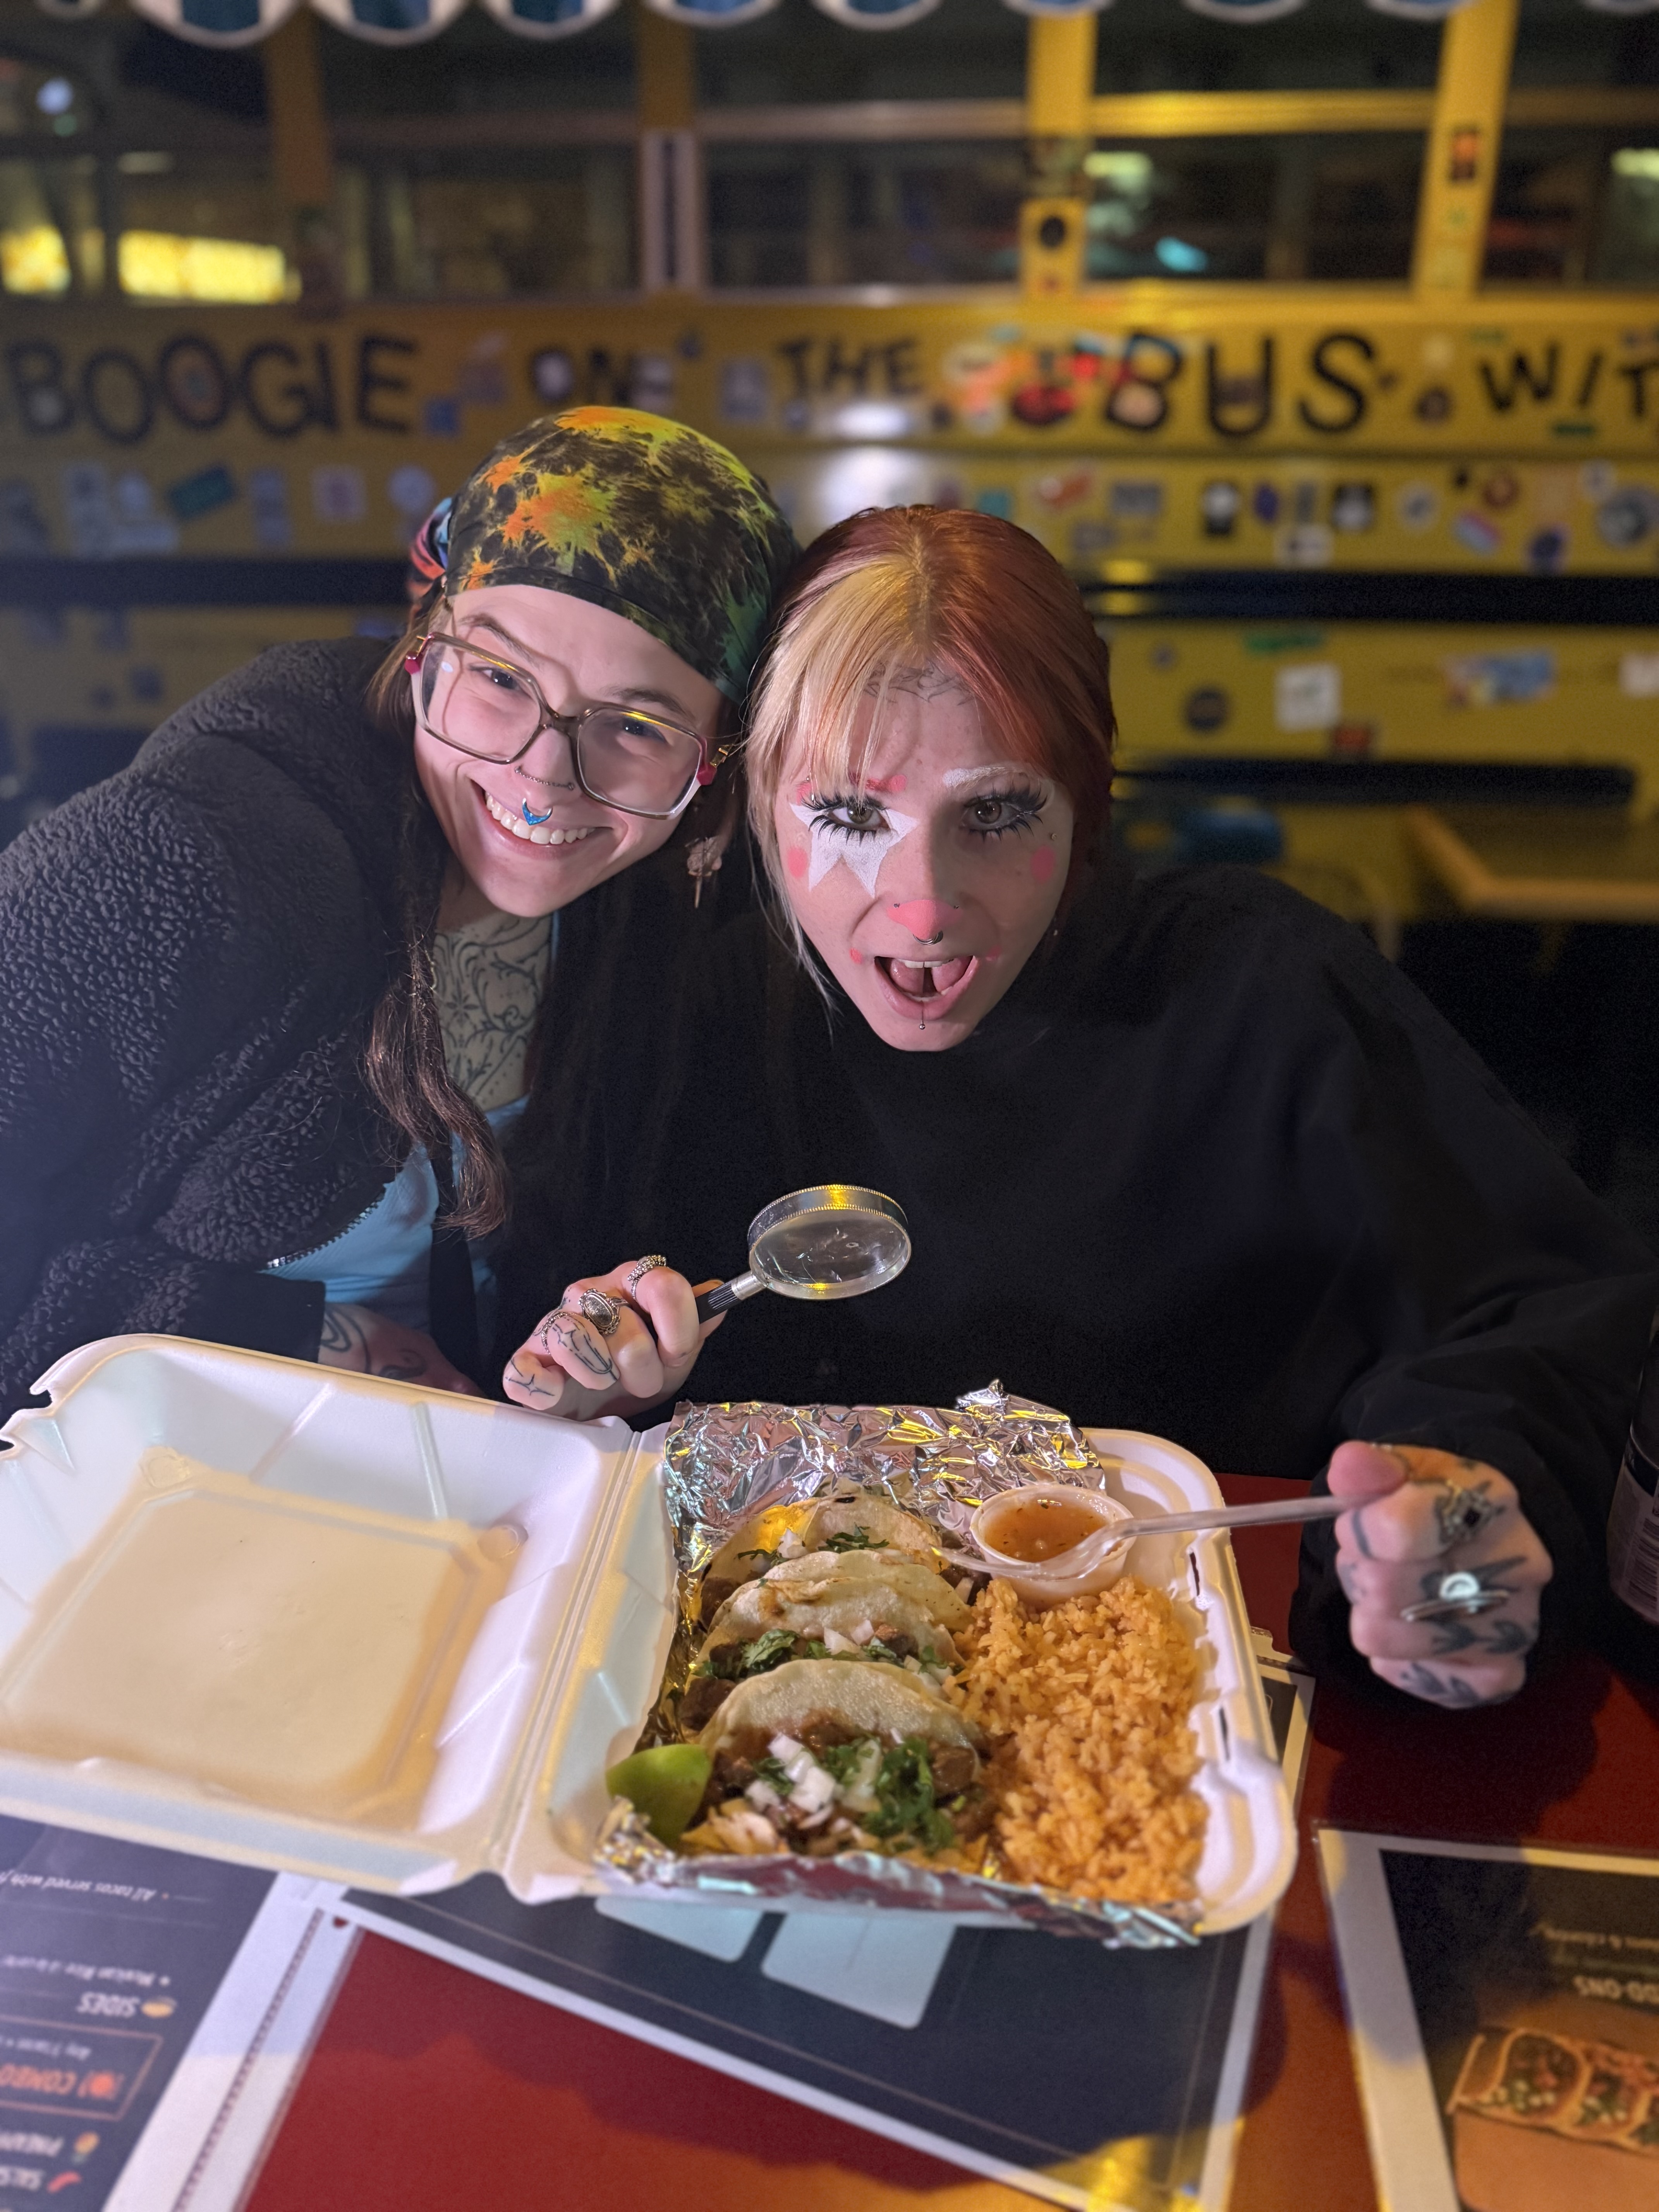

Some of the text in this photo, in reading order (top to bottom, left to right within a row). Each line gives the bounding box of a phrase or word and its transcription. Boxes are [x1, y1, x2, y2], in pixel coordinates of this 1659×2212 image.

[6, 333, 419, 444] BOOGIE
[778, 335, 922, 398] THE
[1104, 331, 1377, 437] BUS
[1479, 340, 1659, 421] WIT
[10, 1873, 43, 1887] with
[41, 1876, 93, 1892] served
[94, 1882, 134, 1897] tacos
[131, 1887, 156, 1901] All
[76, 1992, 140, 2018] SIDES
